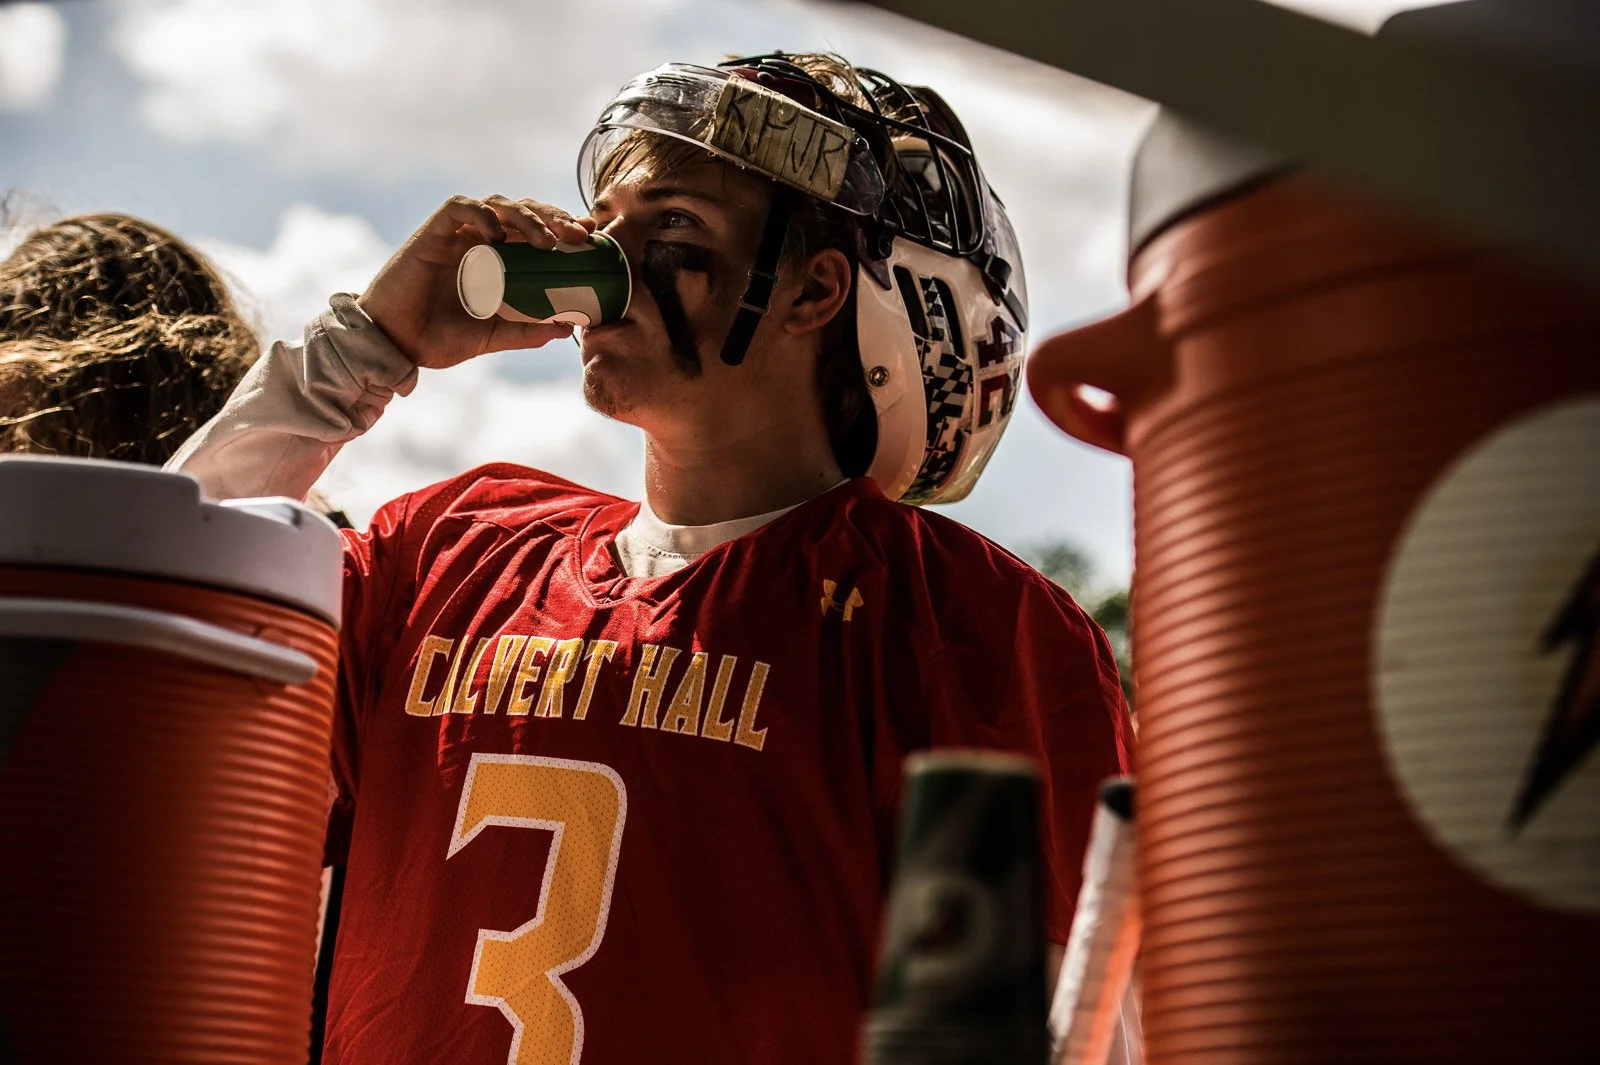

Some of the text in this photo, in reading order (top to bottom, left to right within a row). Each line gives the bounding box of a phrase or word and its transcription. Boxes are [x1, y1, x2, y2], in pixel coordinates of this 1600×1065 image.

[405, 634, 771, 751] CALVERT HALL
[446, 753, 627, 1065] 3
